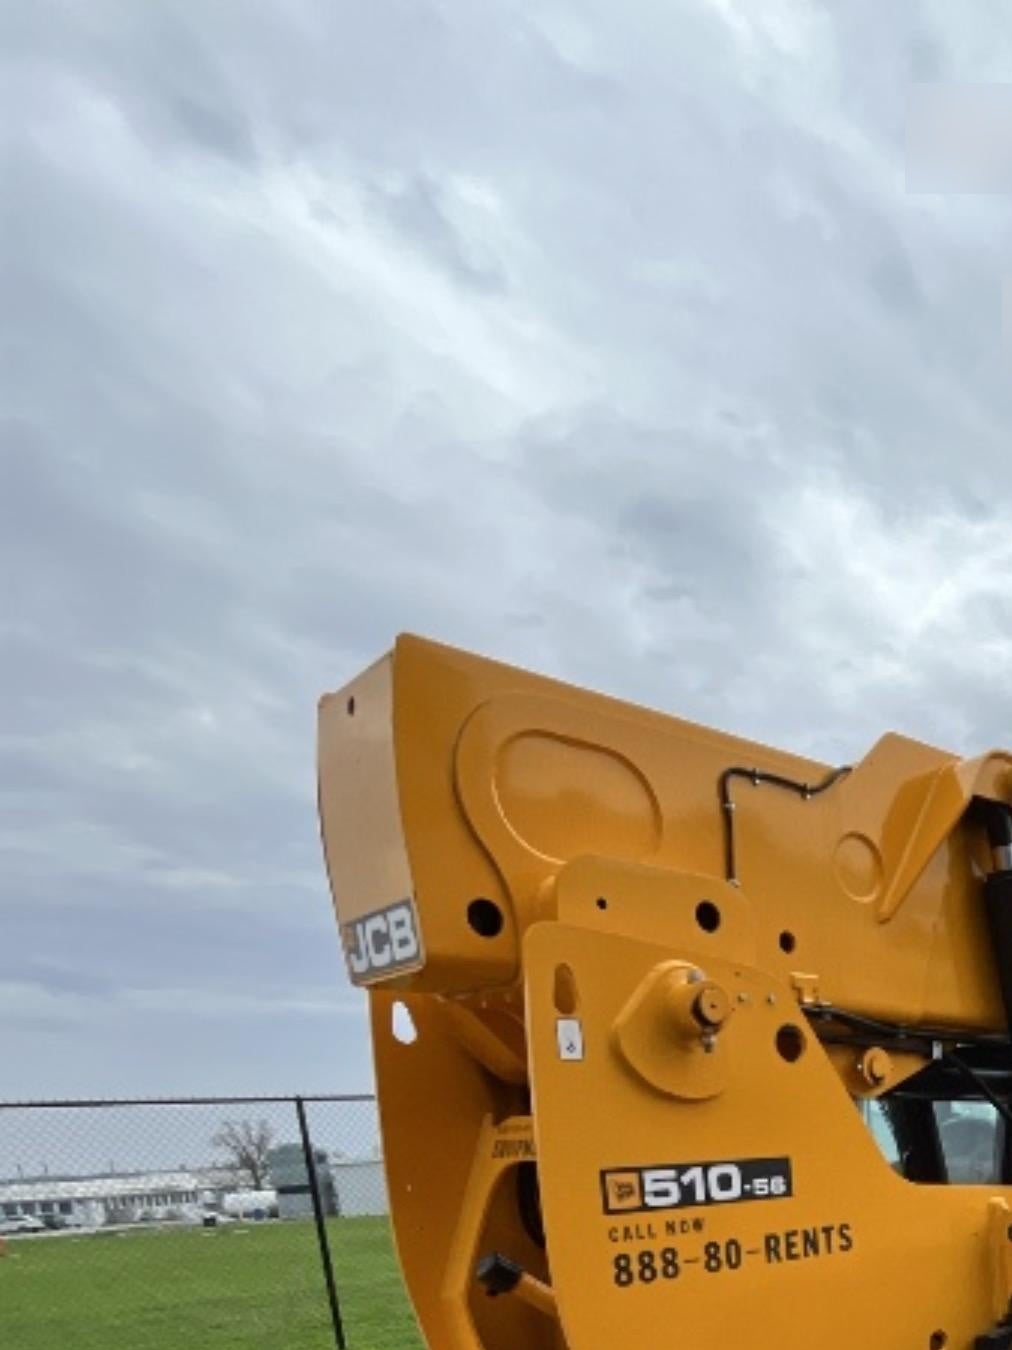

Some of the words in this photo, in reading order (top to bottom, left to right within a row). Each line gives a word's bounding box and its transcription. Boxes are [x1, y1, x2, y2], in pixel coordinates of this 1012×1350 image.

[349, 904, 418, 974] JCB
[608, 1223, 658, 1243] CALL
[665, 1216, 706, 1236] NOW
[612, 1222, 854, 1288] 888-80-RENTS
